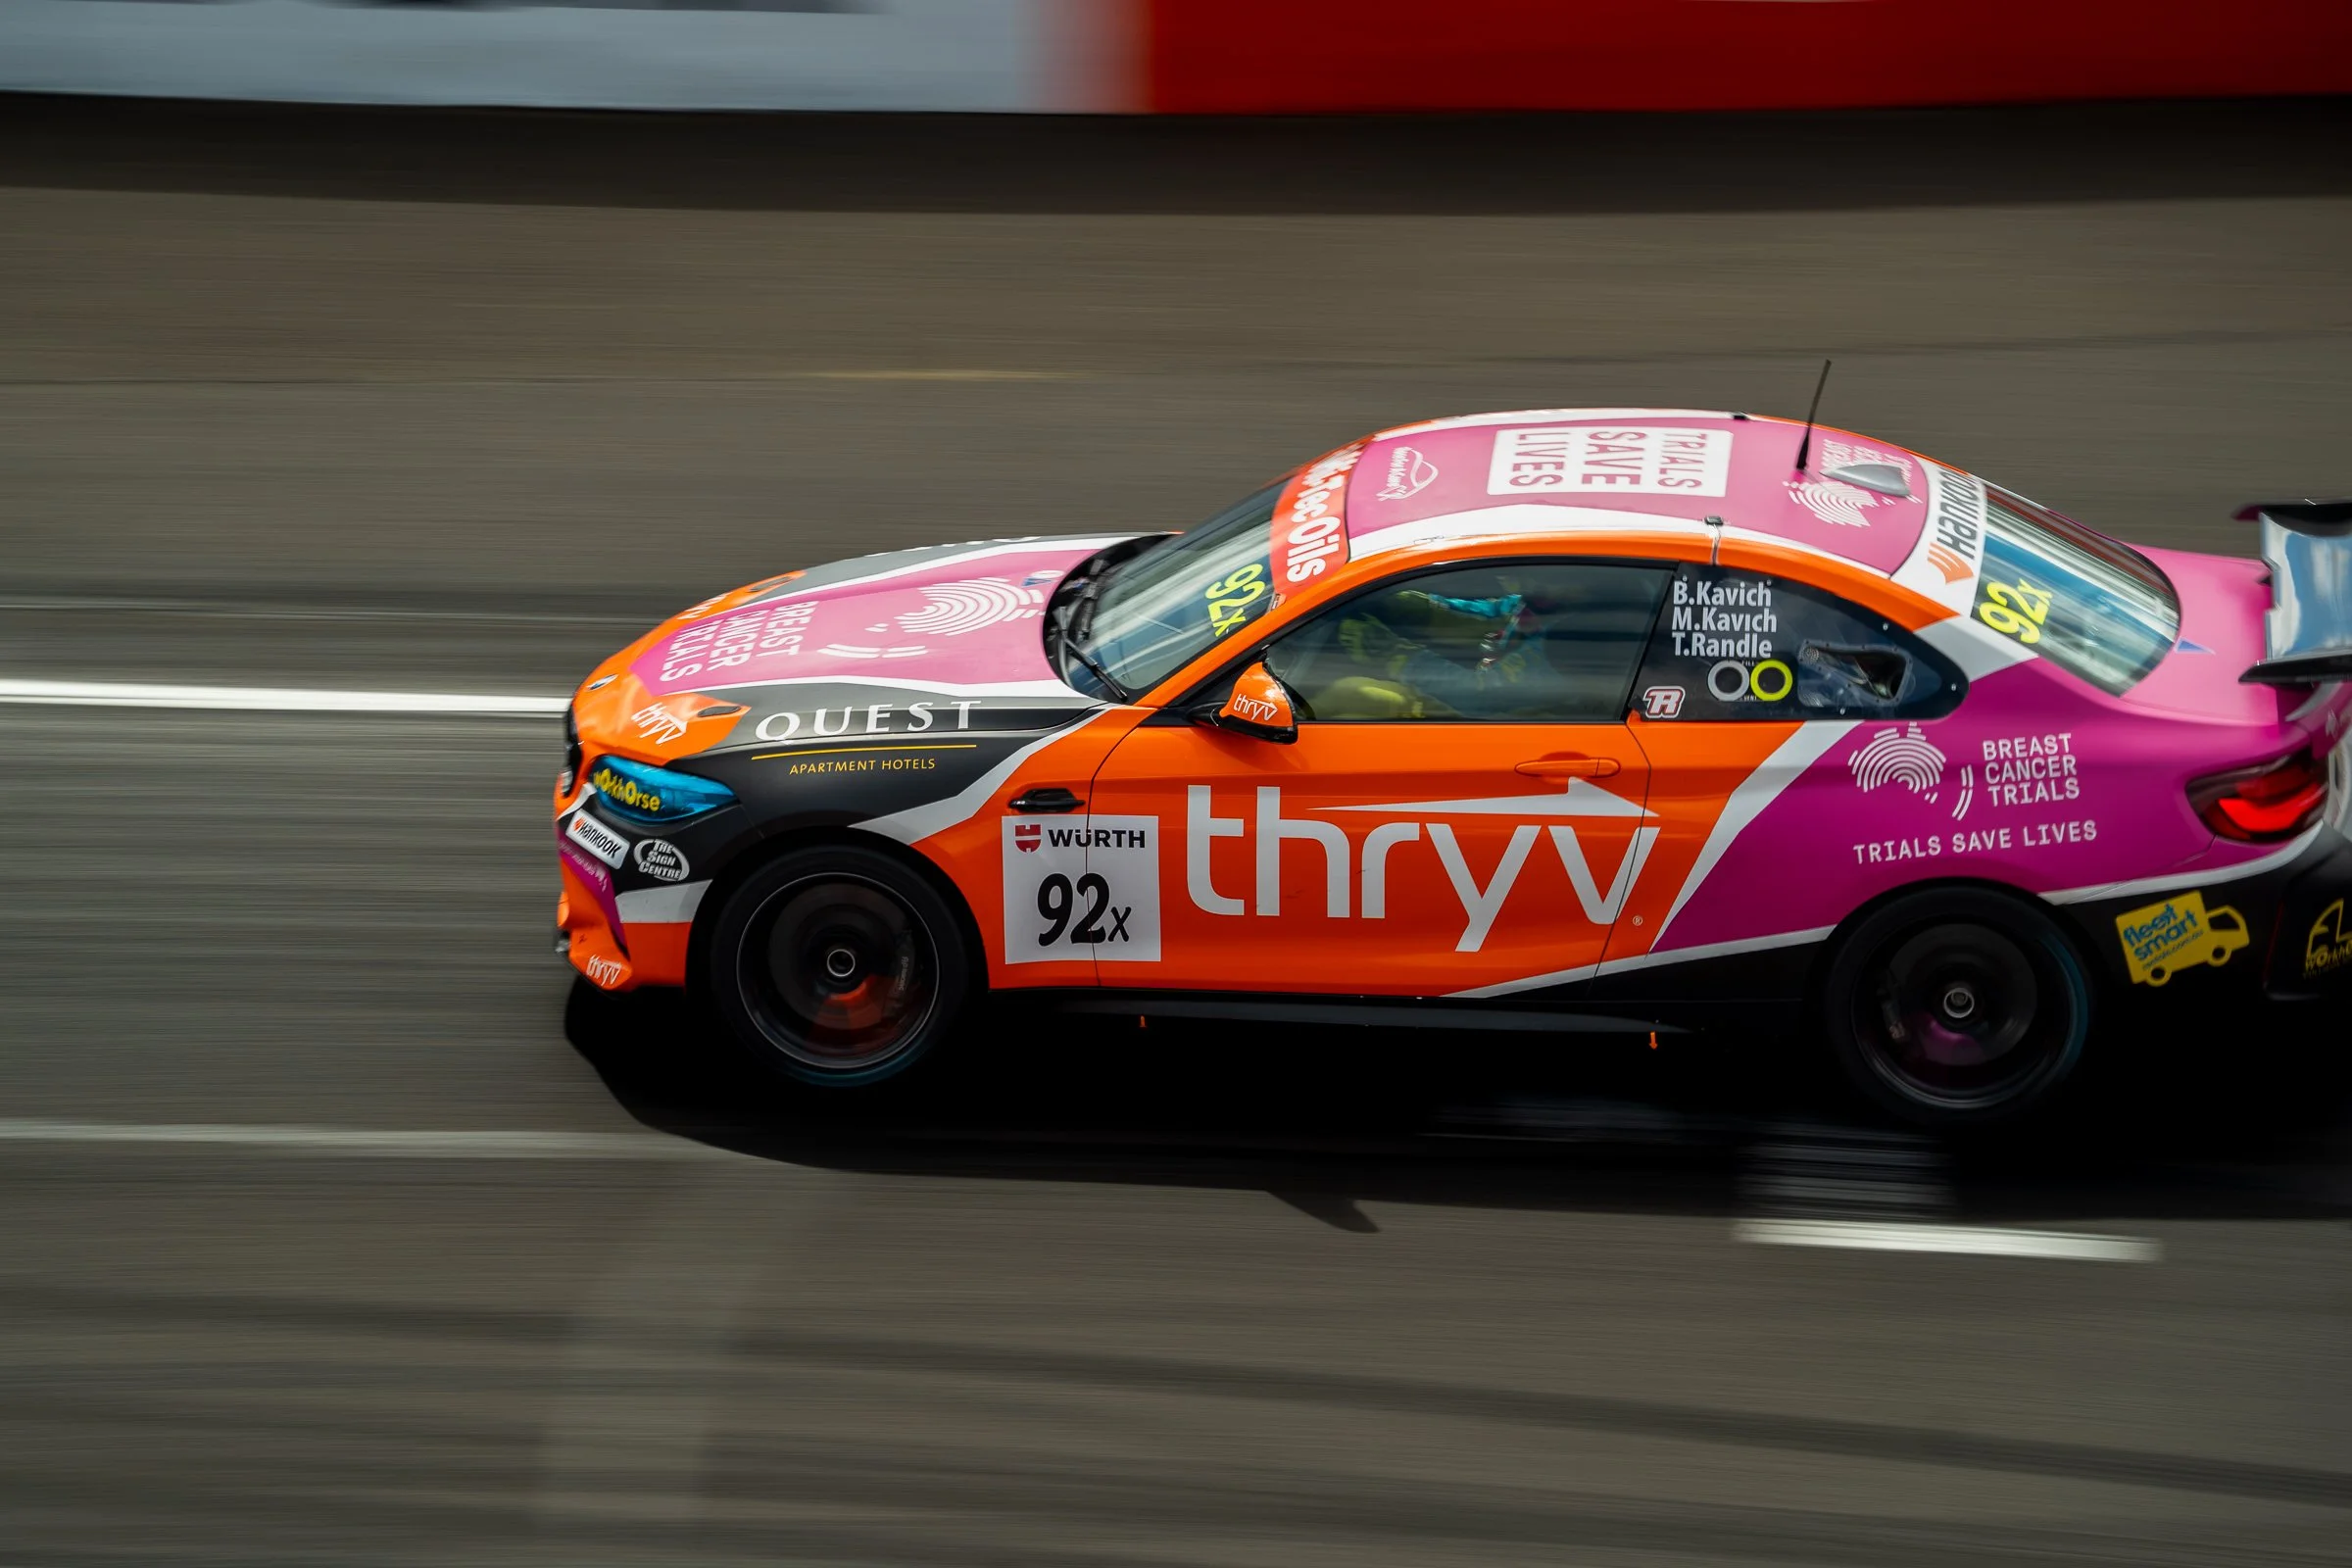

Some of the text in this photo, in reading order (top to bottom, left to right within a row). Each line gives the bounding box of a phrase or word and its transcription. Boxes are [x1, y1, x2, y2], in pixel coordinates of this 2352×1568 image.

[1509, 432, 1569, 487] LIVES
[1582, 431, 1648, 485] SAVE
[1657, 433, 1707, 488] TRIALS
[660, 619, 723, 681] TRIALS
[707, 610, 771, 671] CANCER
[756, 601, 819, 657] BREAST
[631, 702, 687, 745] thryv
[755, 701, 981, 745] QUEST
[1234, 694, 1278, 721] thryv
[789, 758, 936, 775] APARTMENT HOTELS
[1983, 733, 2072, 761] BREAST
[1984, 755, 2077, 784] CANCER
[1987, 777, 2080, 808] TRIALS
[653, 839, 674, 855] THE
[1048, 828, 1146, 849] WÜRTH
[1853, 819, 2097, 864] TRIALS SAVE LIVES
[1186, 777, 1661, 953] thryv
[1037, 872, 1132, 947] 92x
[2123, 903, 2178, 948] fleet
[2134, 909, 2198, 960] smart
